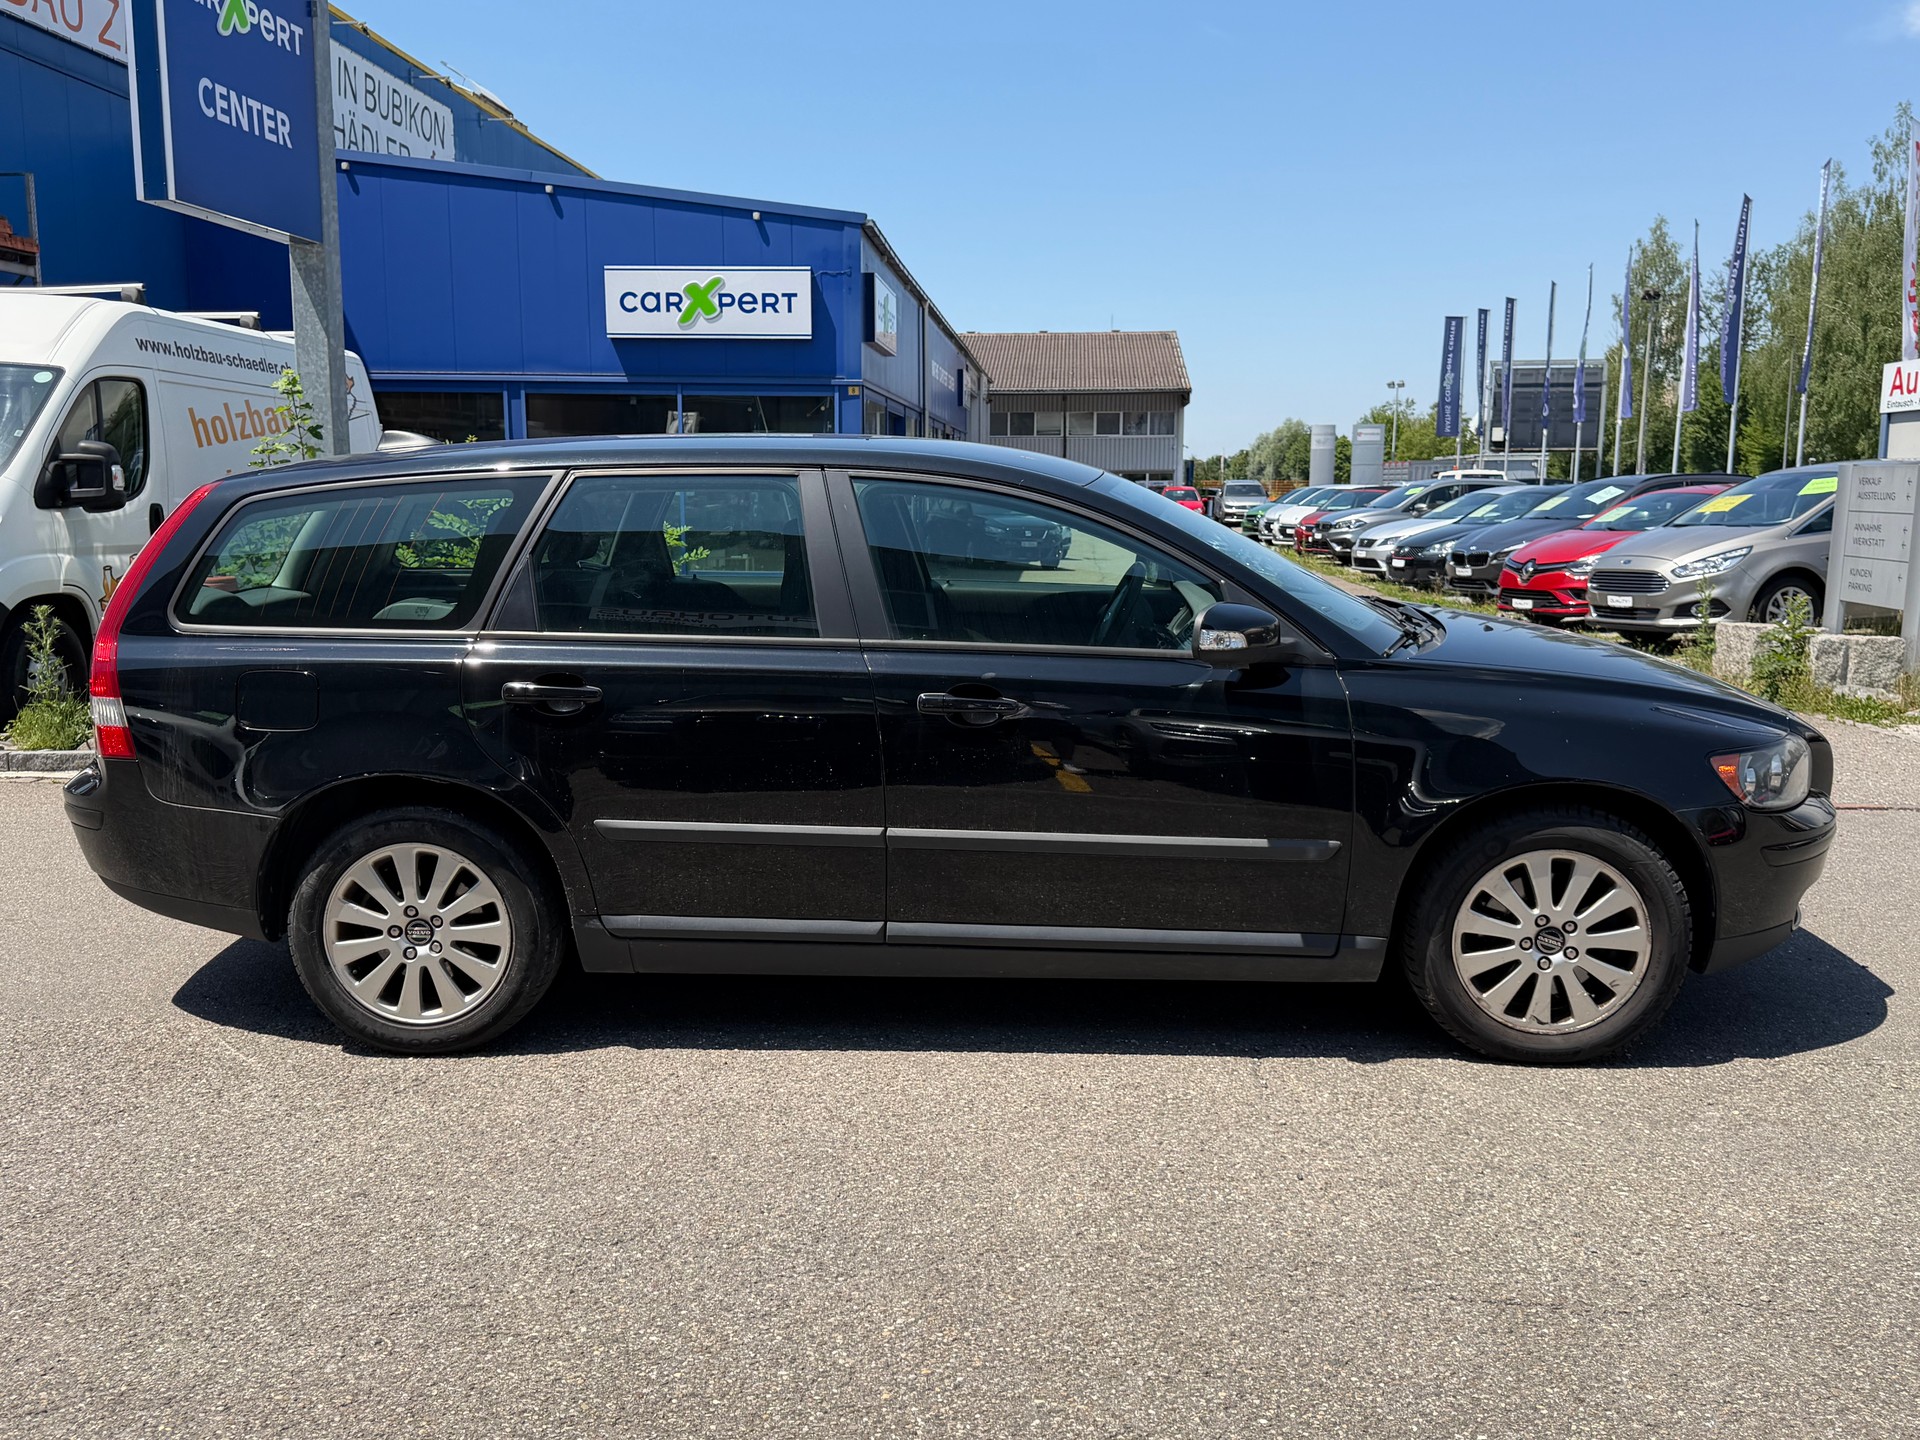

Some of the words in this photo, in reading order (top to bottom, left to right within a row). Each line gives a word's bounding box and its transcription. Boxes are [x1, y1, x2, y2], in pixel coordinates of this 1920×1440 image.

[338, 57, 358, 105] IN
[364, 72, 446, 150] BUBIKON
[198, 77, 293, 149] CENTER
[1858, 477, 1882, 486] VERKAUF
[1857, 491, 1896, 501] AUSSTELLUNG
[1854, 523, 1882, 533] ANNAHME
[1852, 536, 1885, 548] WERKSTATT
[1849, 567, 1872, 578] KUNDEN
[1848, 581, 1872, 593] PARKING
[1537, 935, 1562, 947] VOLVO
